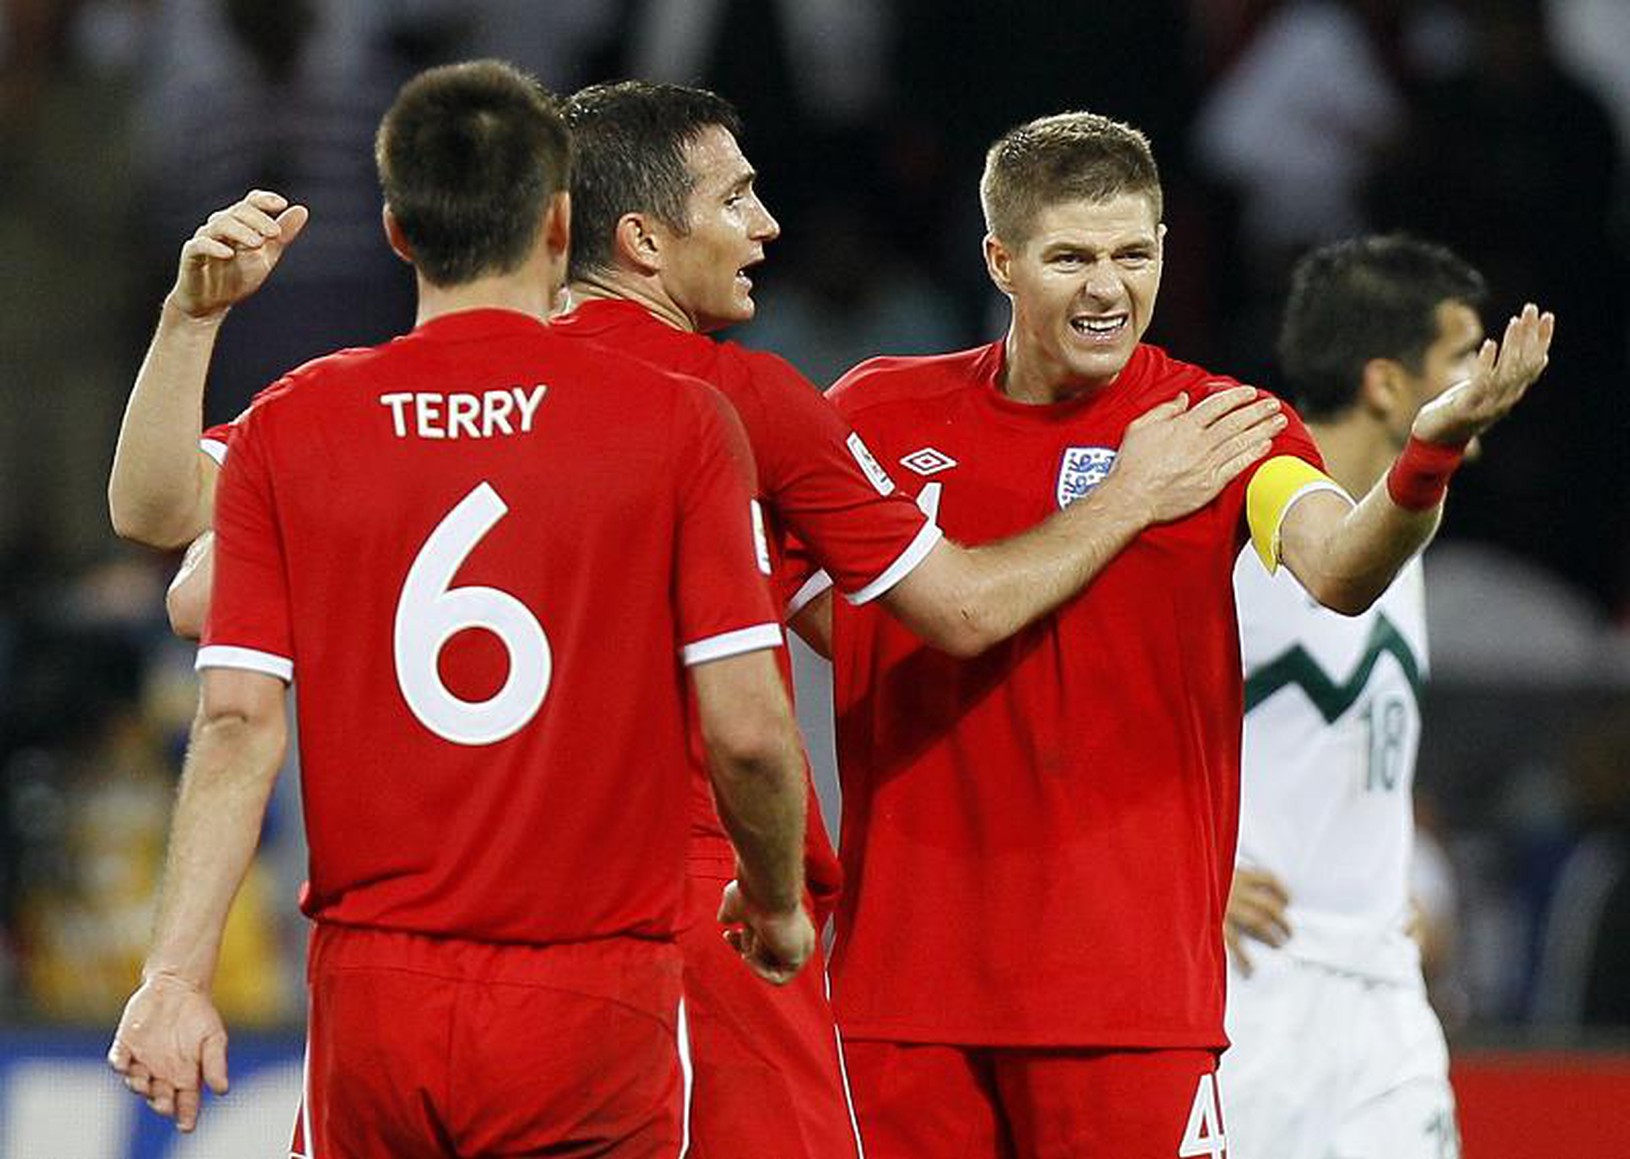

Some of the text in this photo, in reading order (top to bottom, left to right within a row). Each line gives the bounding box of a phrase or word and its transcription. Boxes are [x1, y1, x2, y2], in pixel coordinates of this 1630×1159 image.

[380, 385, 547, 439] TERRY
[393, 481, 552, 746] 6
[1358, 697, 1405, 791] 18
[1178, 1073, 1228, 1159] 4
